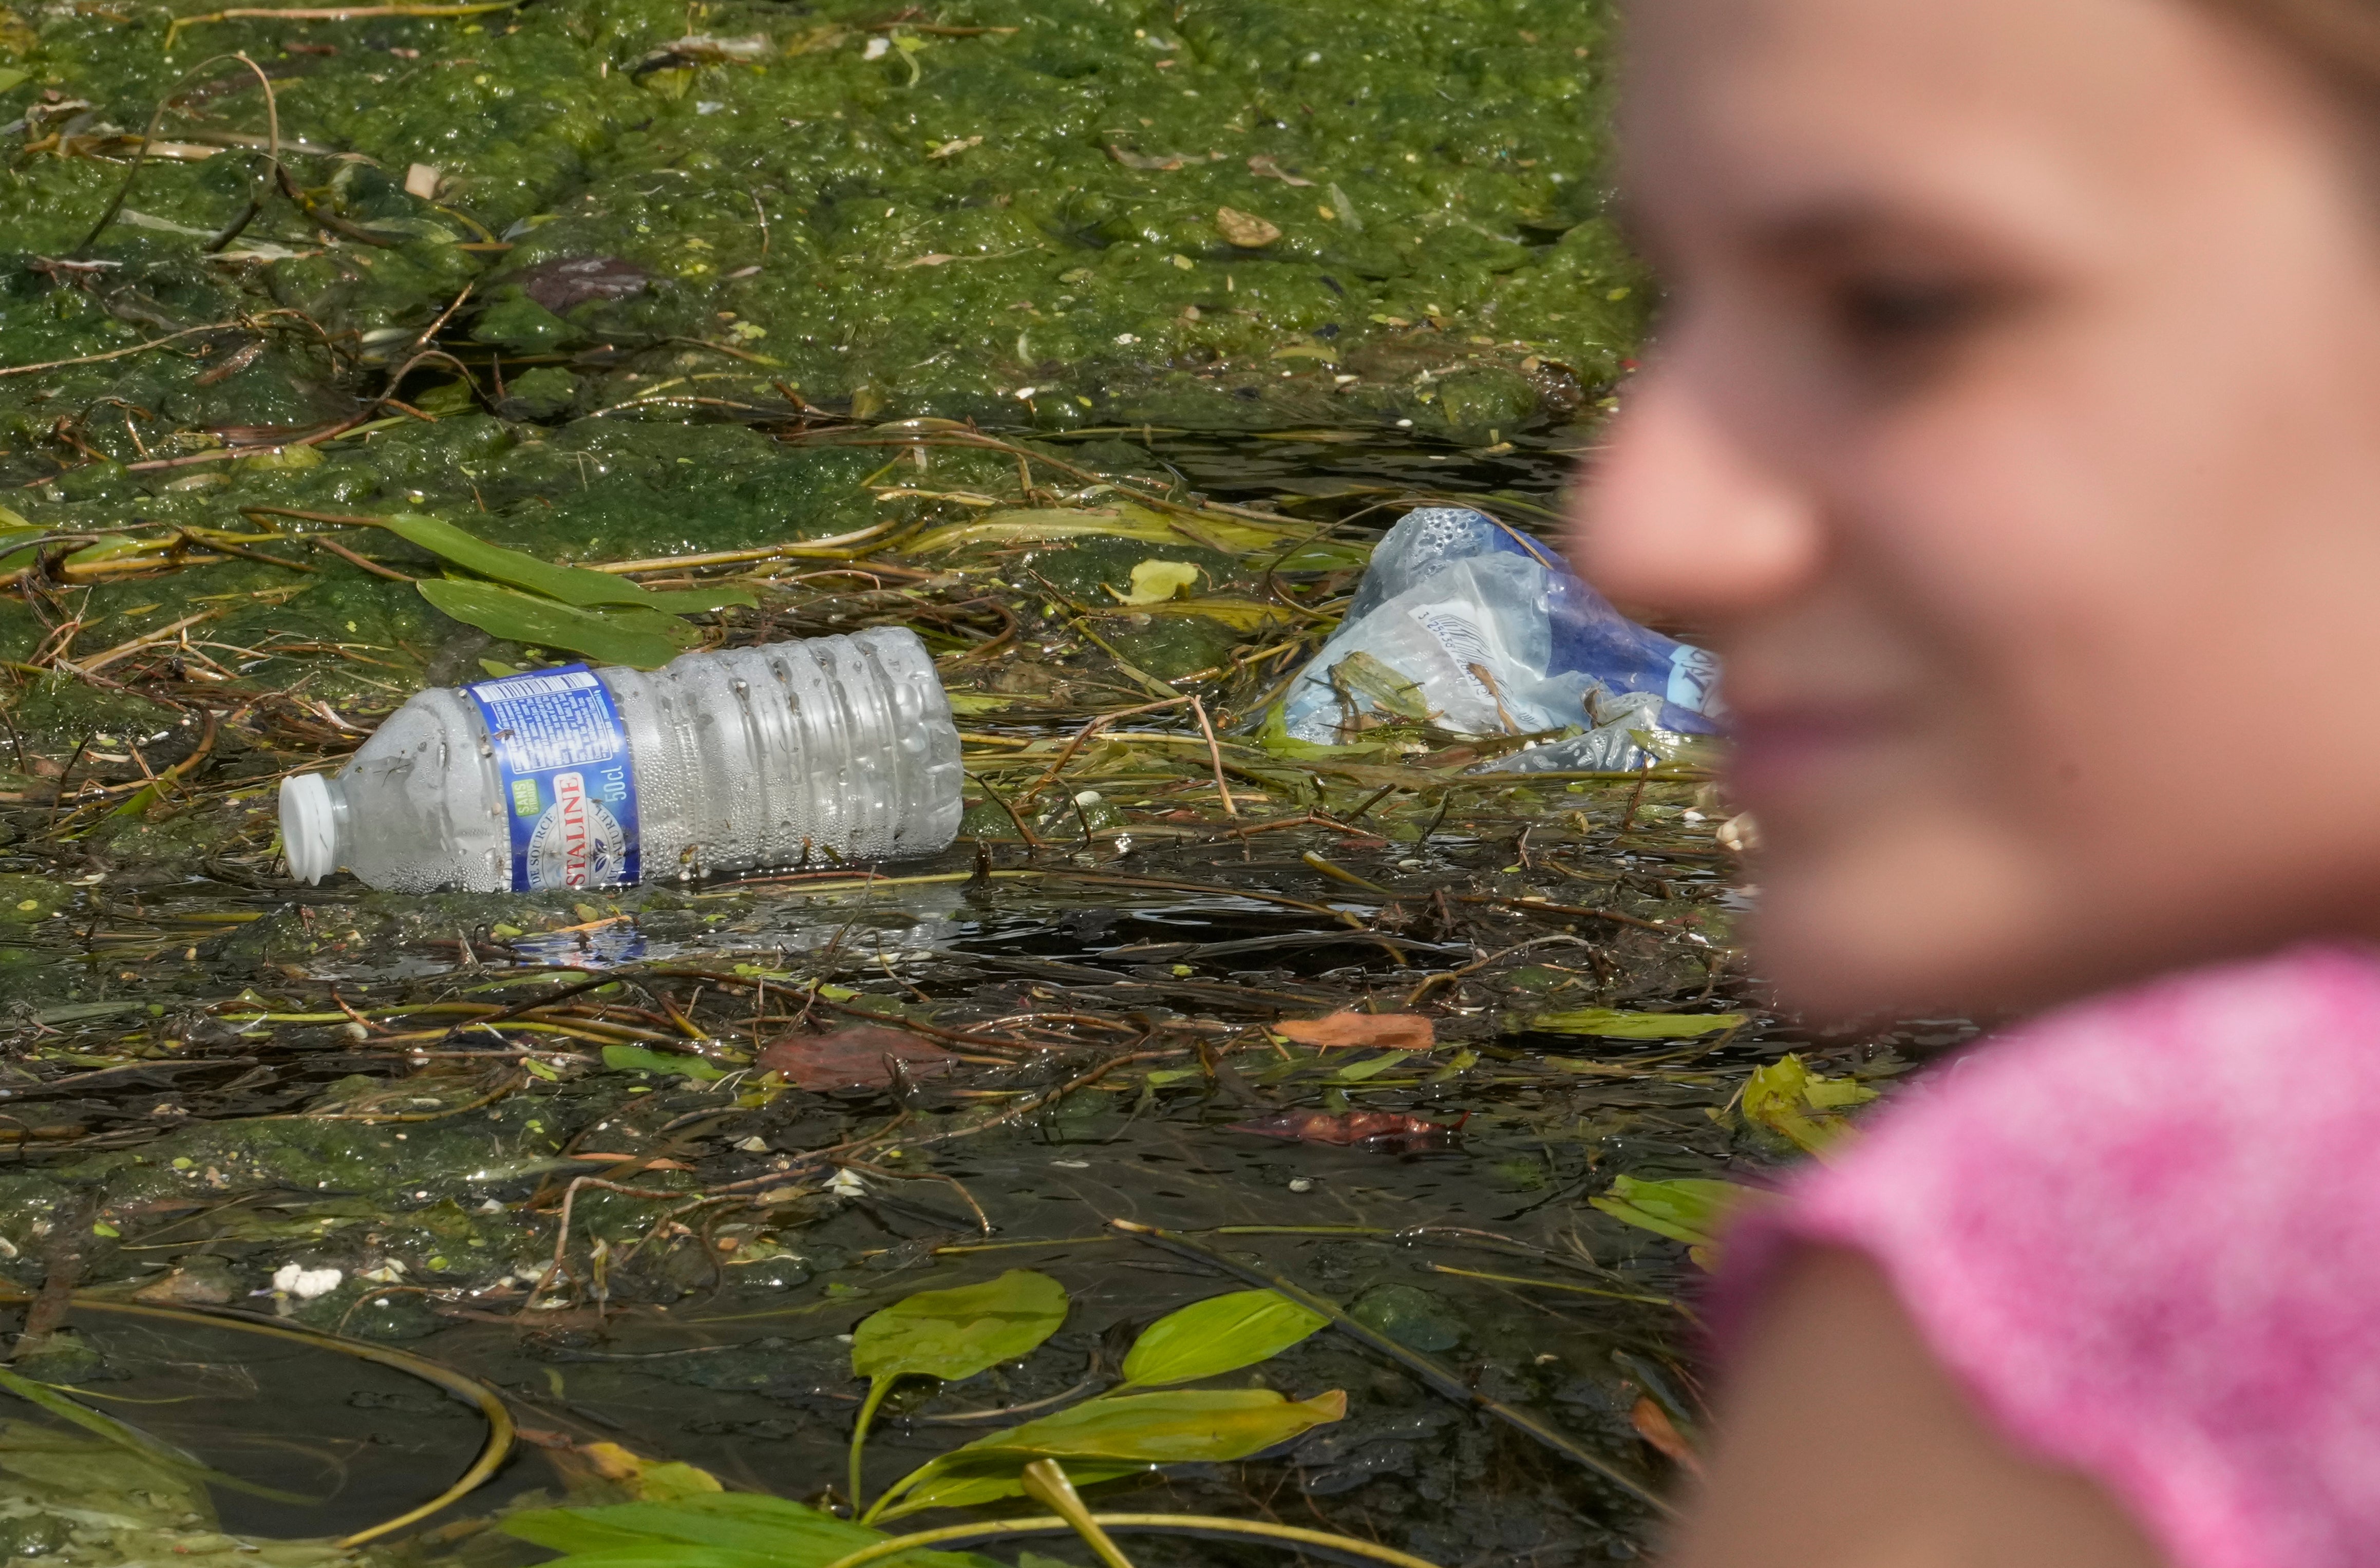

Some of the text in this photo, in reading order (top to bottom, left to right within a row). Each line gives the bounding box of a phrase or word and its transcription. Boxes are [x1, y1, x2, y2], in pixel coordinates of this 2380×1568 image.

[514, 783, 527, 814] SANS
[600, 765, 627, 803] 50cl
[530, 813, 556, 866] SOURCE
[594, 805, 622, 864] NATUREL
[530, 868, 541, 884] DE
